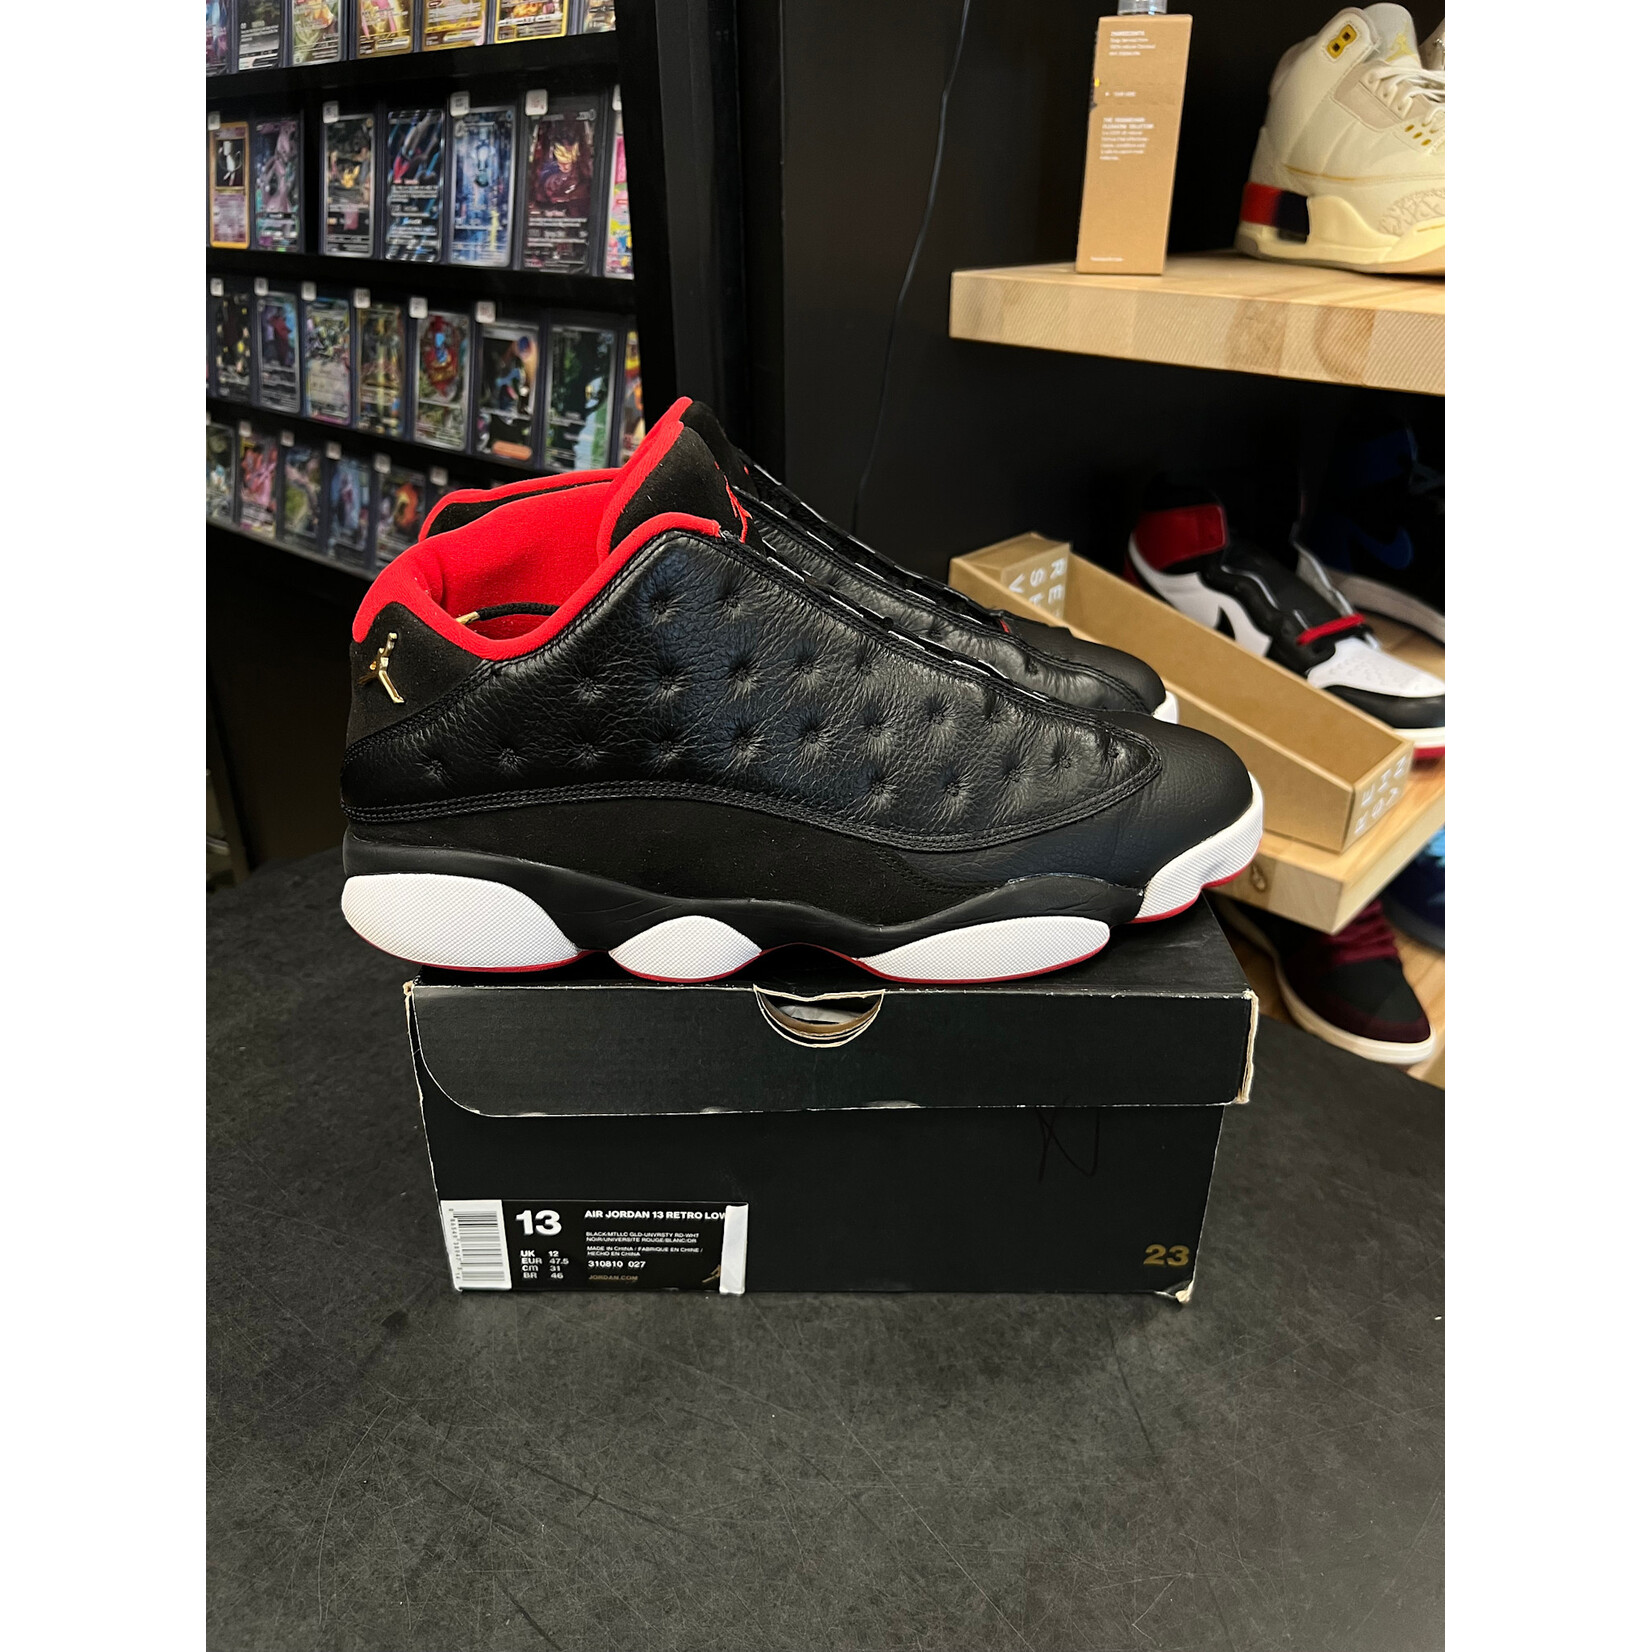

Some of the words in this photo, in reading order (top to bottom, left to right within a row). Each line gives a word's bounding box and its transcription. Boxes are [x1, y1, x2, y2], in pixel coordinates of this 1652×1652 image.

[515, 1210, 562, 1235] 13
[584, 1210, 604, 1219] AIR
[605, 1210, 650, 1219] JORDAN
[652, 1211, 664, 1219] 13
[666, 1211, 703, 1220] RETRO
[1143, 1244, 1190, 1266] 23
[588, 1260, 623, 1268] 310810
[628, 1260, 646, 1268] 027
